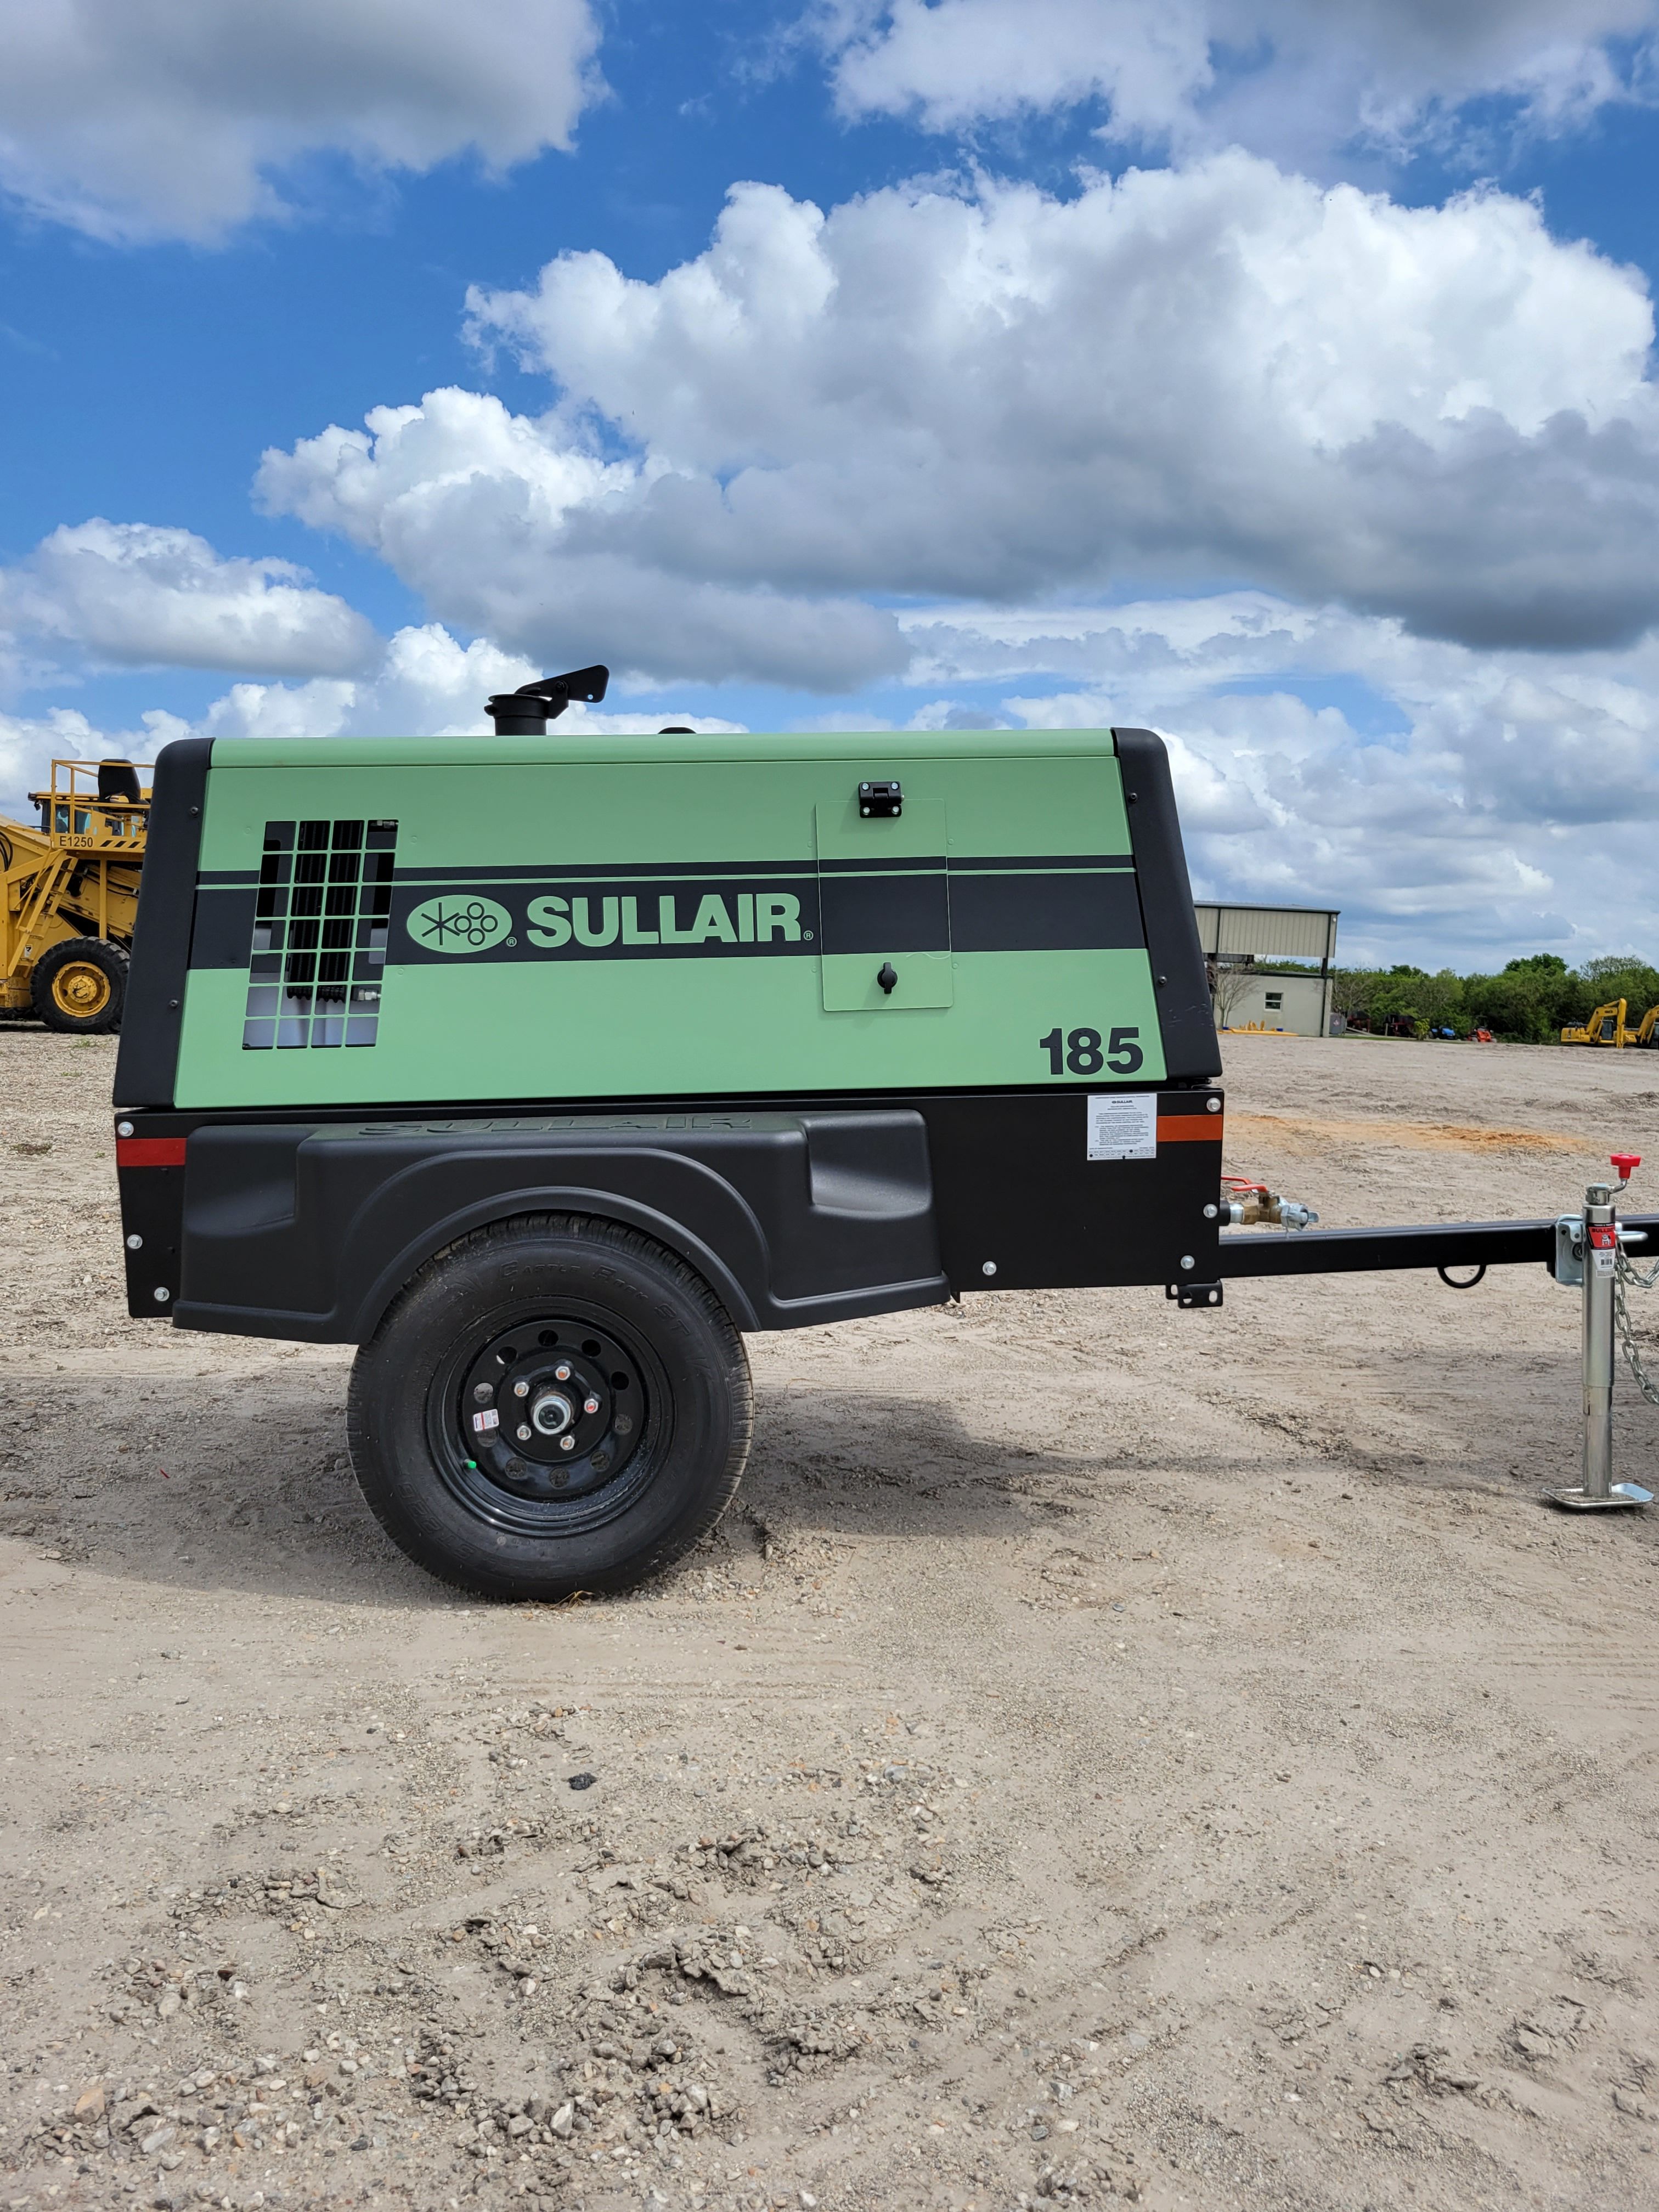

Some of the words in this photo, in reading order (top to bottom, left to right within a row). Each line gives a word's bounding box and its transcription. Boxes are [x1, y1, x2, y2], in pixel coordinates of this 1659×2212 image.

[60, 836, 93, 847] E1250
[526, 893, 802, 948] SULLAIR
[1040, 1027, 1143, 1075] 185
